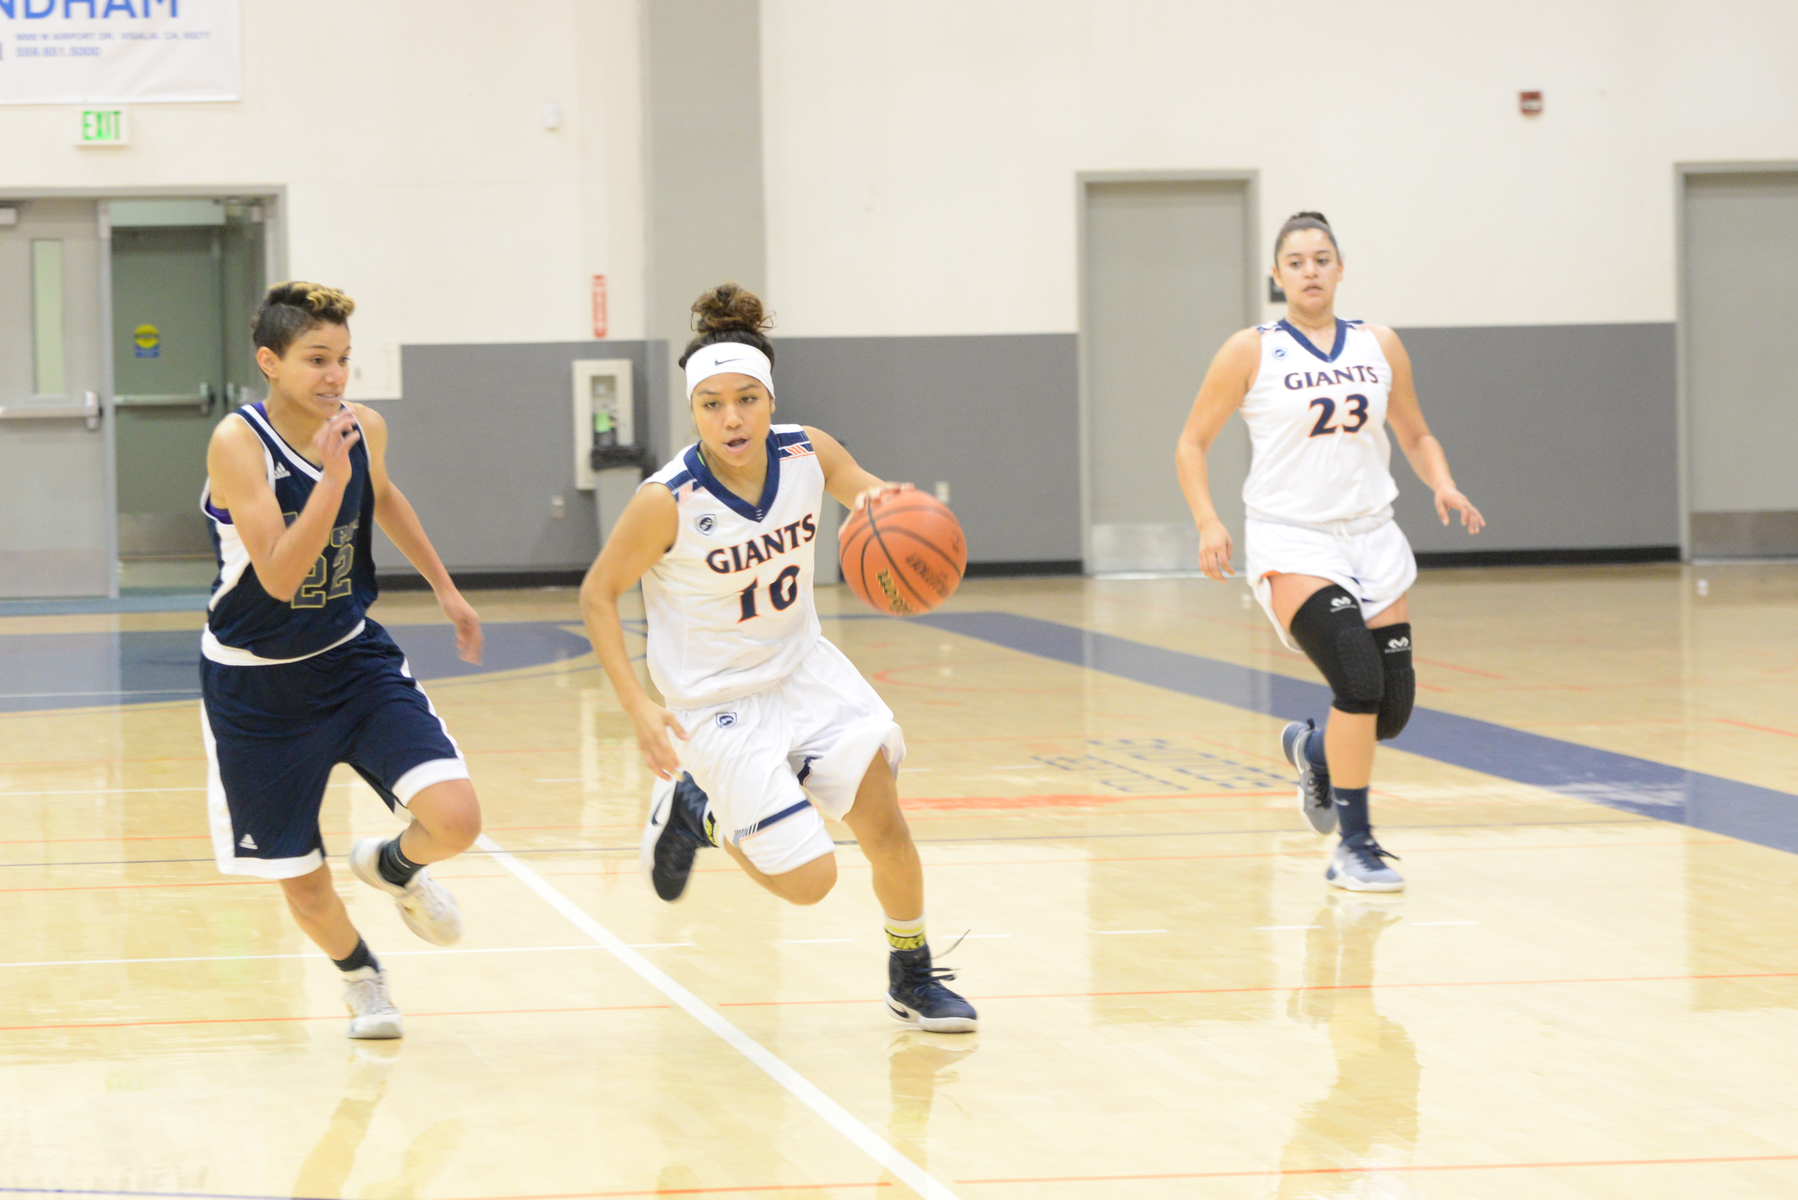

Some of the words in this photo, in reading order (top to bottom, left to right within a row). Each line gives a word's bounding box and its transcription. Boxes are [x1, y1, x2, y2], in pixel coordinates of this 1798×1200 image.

[82, 111, 121, 140] EXIT
[1284, 365, 1379, 391] GIANTS
[1308, 394, 1369, 438] 23
[705, 513, 816, 574] GIANTS
[291, 543, 354, 609] 22
[734, 564, 801, 624] 10
